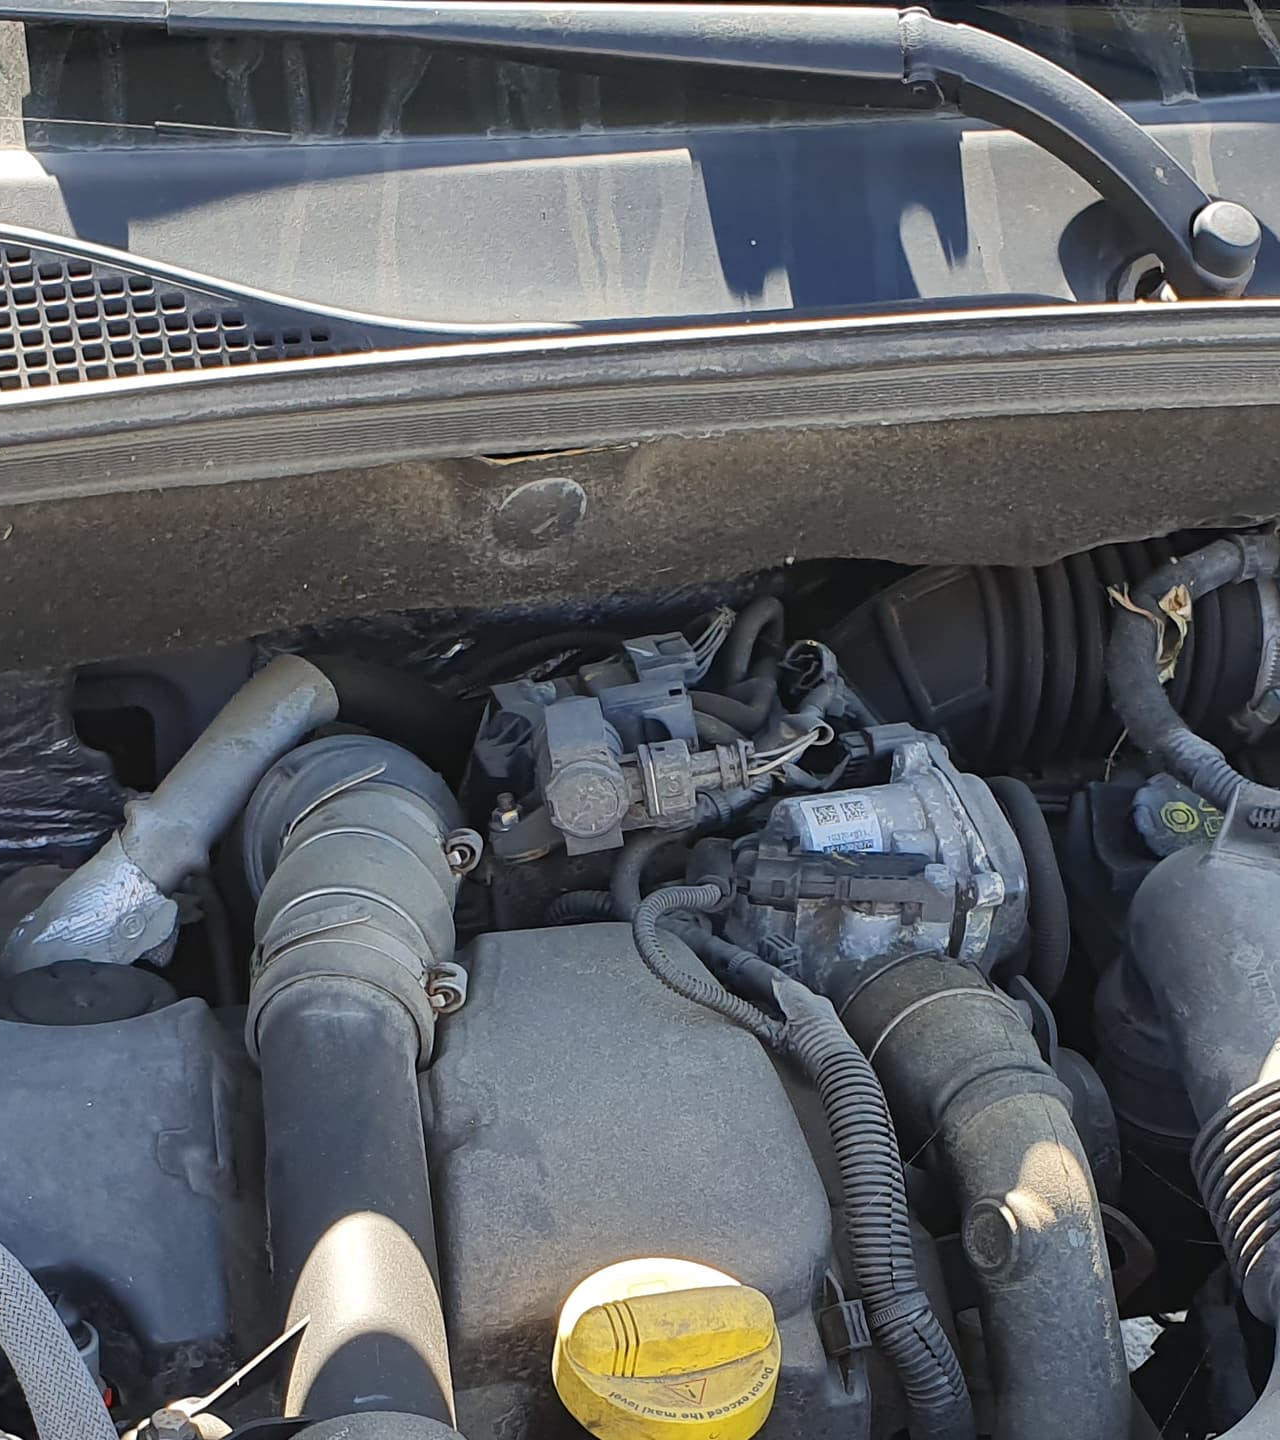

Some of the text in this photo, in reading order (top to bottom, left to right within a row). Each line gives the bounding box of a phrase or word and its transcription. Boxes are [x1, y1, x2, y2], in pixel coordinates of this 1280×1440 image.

[642, 1406, 678, 1419] maxi
[707, 1396, 750, 1419] exceed
[681, 1411, 705, 1421] the
